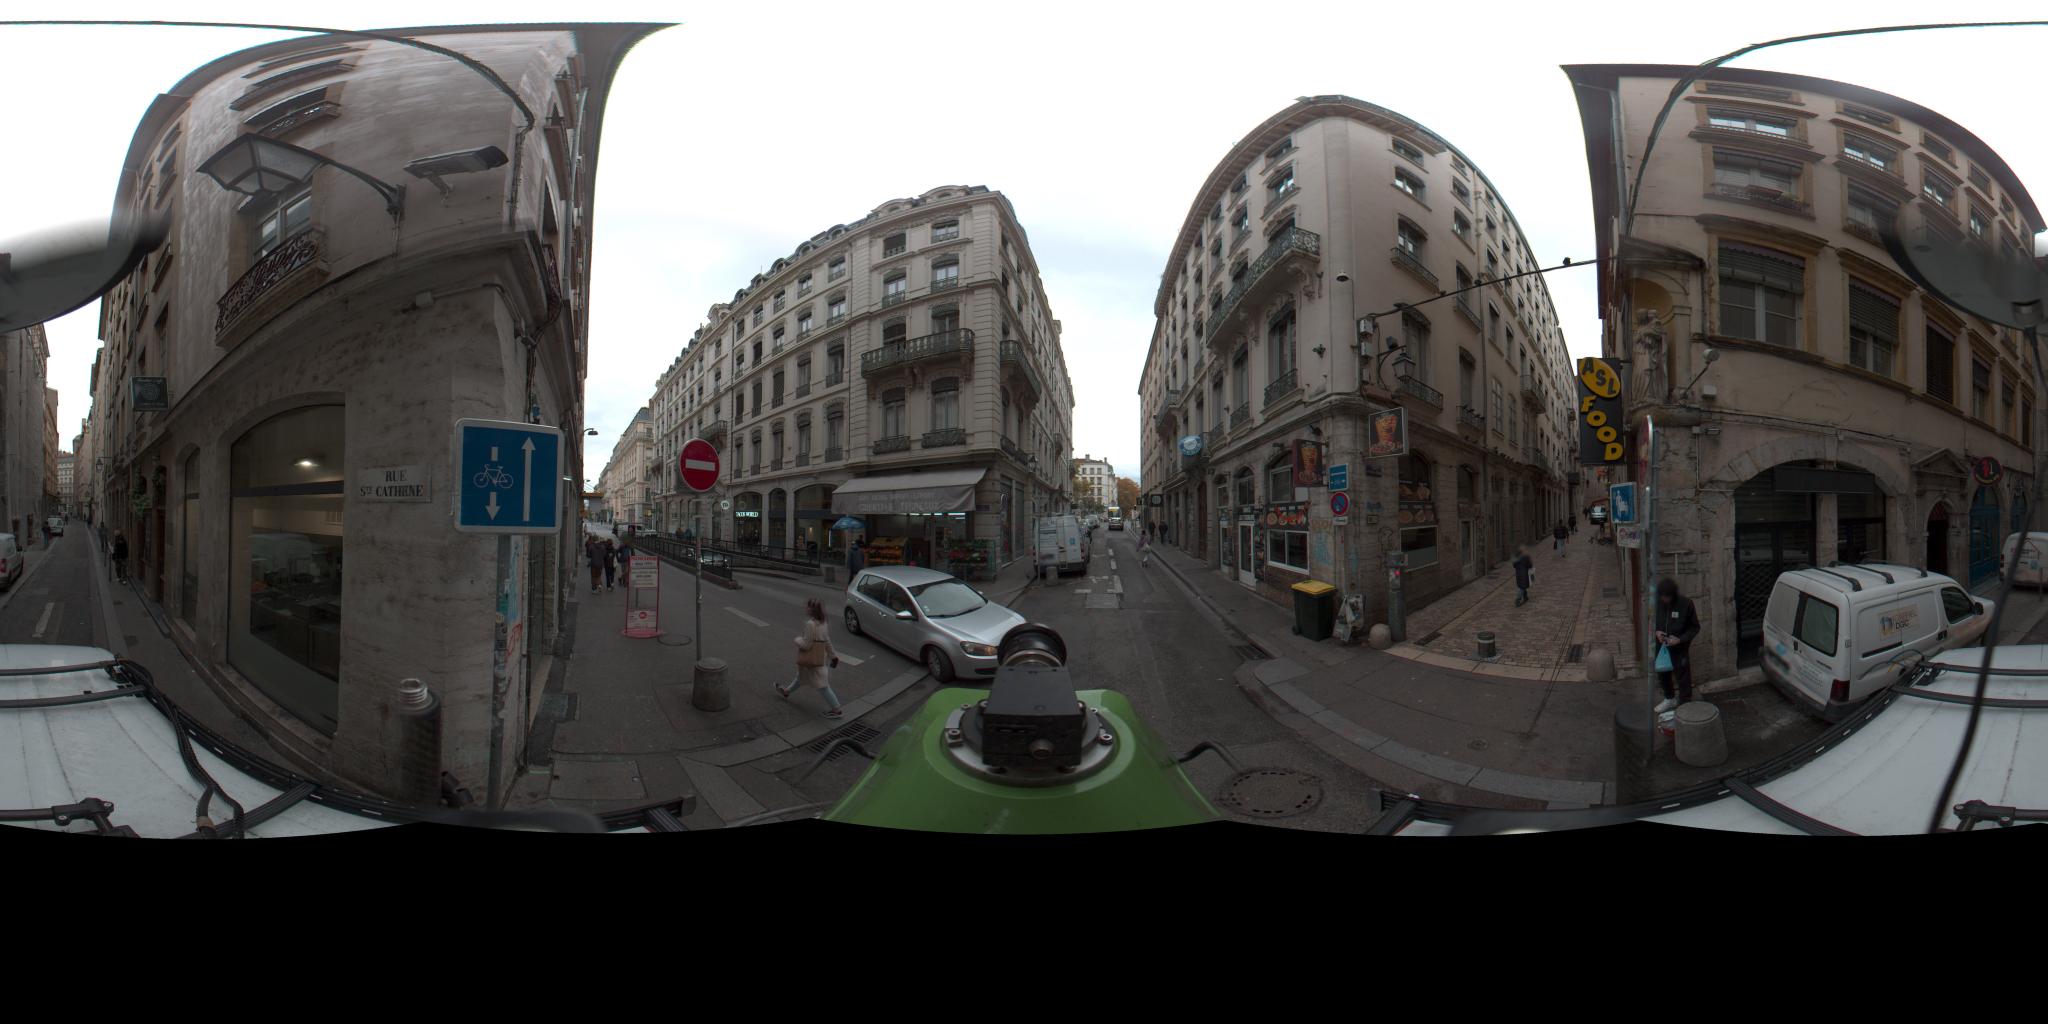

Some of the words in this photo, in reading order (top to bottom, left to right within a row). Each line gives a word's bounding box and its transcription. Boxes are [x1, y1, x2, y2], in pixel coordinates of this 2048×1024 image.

[1582, 357, 1616, 394] ASL
[1580, 396, 1624, 461] FOOD
[385, 470, 407, 482] RUE
